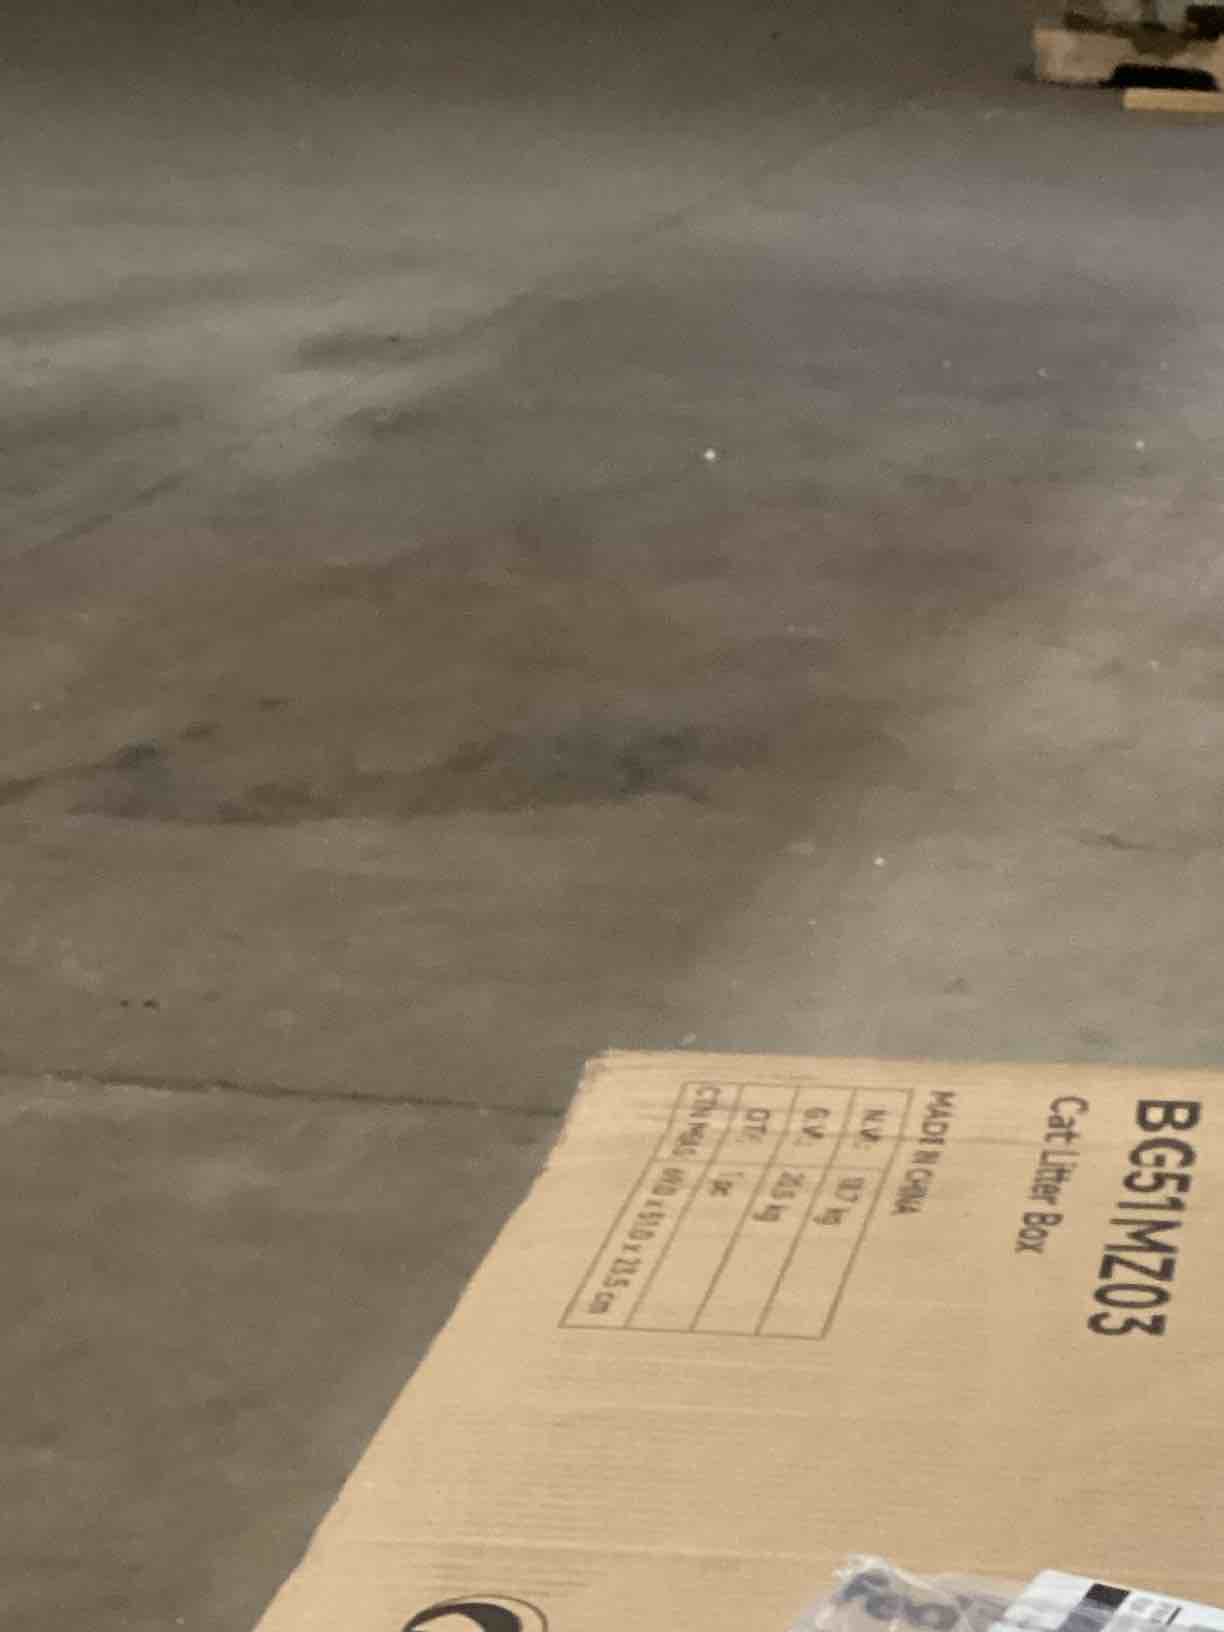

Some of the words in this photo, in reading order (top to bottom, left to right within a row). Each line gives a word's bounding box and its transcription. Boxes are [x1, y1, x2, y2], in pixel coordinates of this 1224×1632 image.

[1044, 1095, 1089, 1145] Cat
[1026, 1149, 1081, 1206] Litter
[1014, 1211, 1064, 1255] Box
[1087, 1099, 1205, 1336] BG51MZ03
